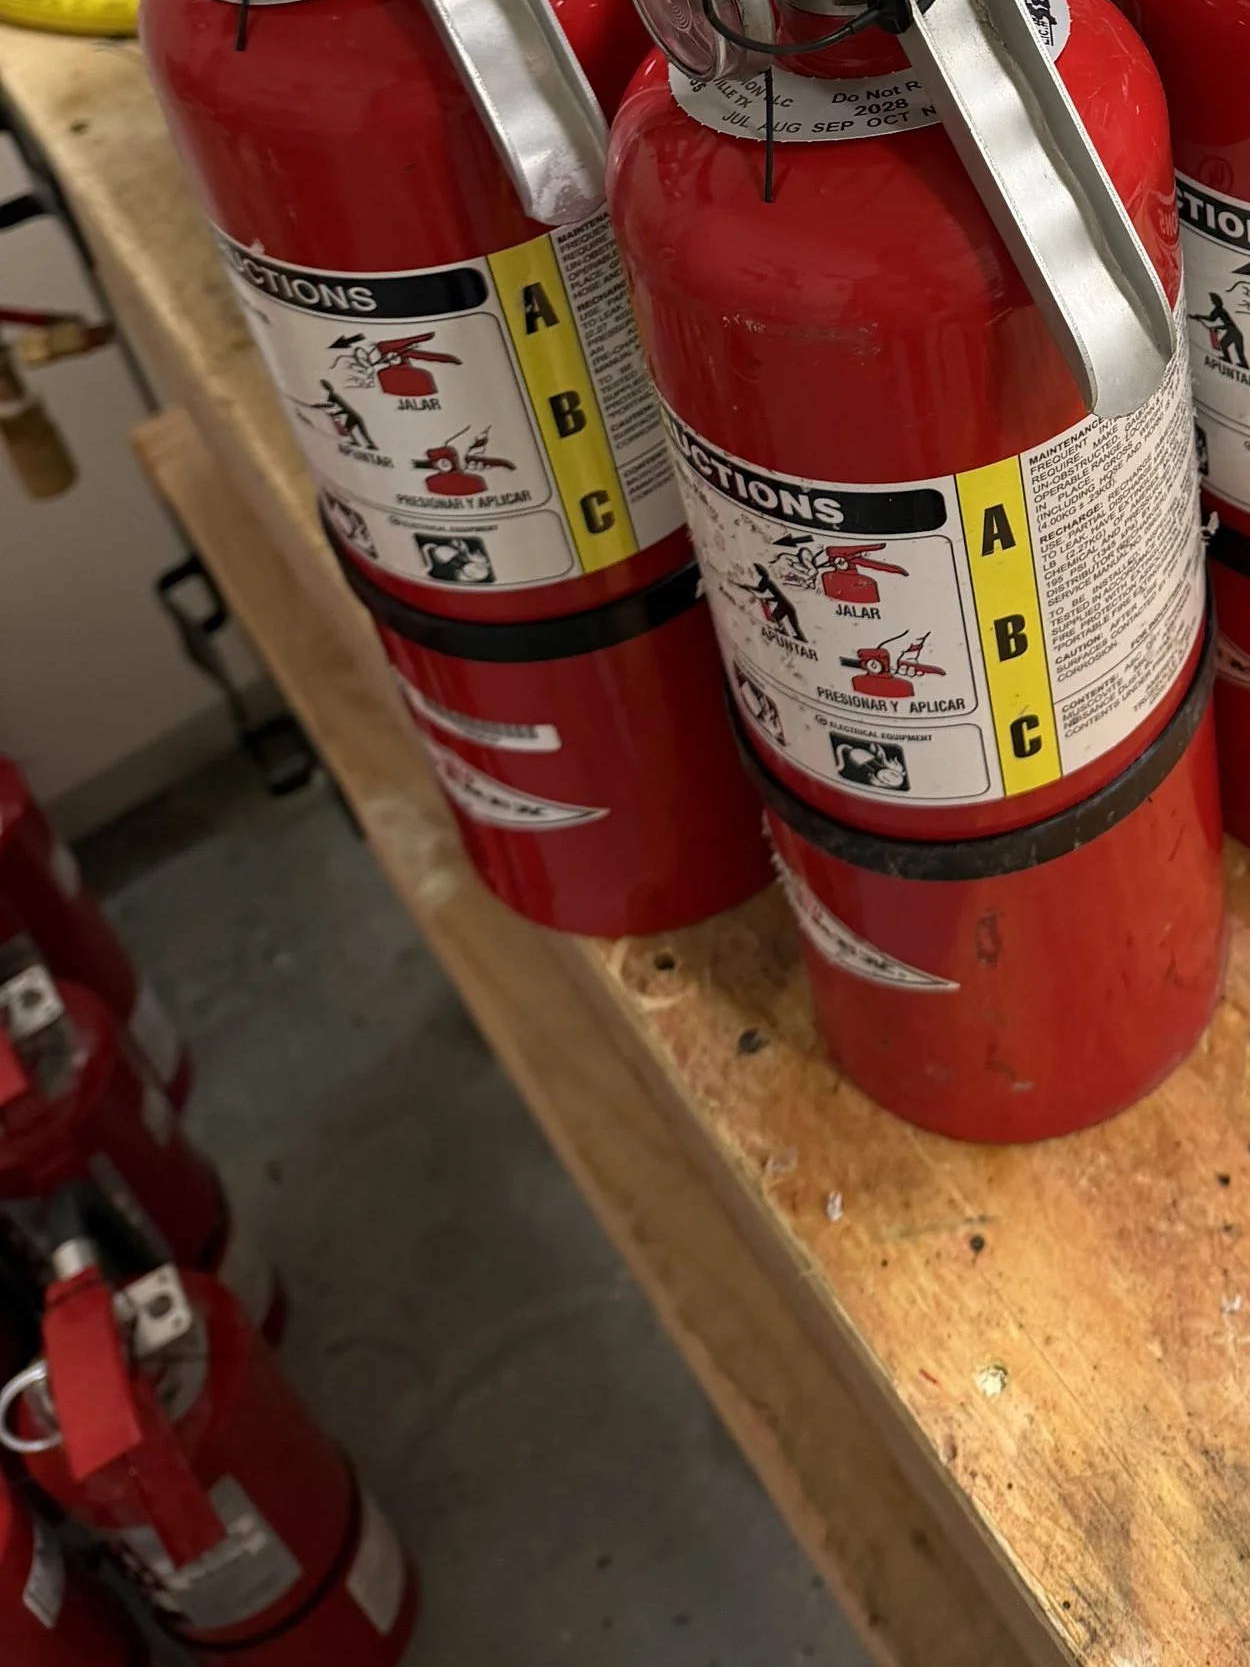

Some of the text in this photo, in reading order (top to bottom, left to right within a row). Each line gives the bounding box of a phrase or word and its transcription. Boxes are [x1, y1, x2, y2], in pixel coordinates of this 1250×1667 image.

[737, 94, 753, 109] TX
[853, 98, 909, 117] 2028
[832, 92, 859, 104] Do
[866, 85, 901, 102] Not
[722, 111, 750, 129] JUL
[811, 120, 855, 133] SEP
[866, 112, 911, 128] OCT
[558, 212, 610, 244] MAINTENA
[227, 248, 377, 312] UCTIONS
[397, 397, 441, 411] JALAR
[522, 281, 616, 535] A B C
[671, 421, 845, 524] UCTIONS
[1030, 437, 1088, 475] FREQUENT
[1031, 424, 1118, 485] REQUIRE. MAKE
[1032, 436, 1120, 494] UN-OBSTRUCTED.
[1034, 468, 1089, 503] OPERABLE
[1035, 441, 1133, 513] IN PLACE. GROSS
[1036, 441, 1142, 523] (INCLUDING HOSE AND
[395, 490, 531, 510] PRESIONAR Y APLICAR
[1037, 507, 1077, 532] (4.00KG
[1040, 502, 1104, 544] RECHARGE:
[1040, 510, 1107, 553] USE. PARTIAL
[1042, 550, 1057, 563] TO
[1090, 512, 1116, 534] HAVE
[1043, 529, 1107, 571] LB (2.27KG)
[1044, 526, 1121, 580] CHEMICAL AND
[1046, 562, 1087, 589] 195 PSI
[1047, 549, 1115, 598] DISTRIBUTOR
[1047, 549, 1129, 607] SERVICE MANUAL
[835, 603, 881, 620] JALAR
[1049, 594, 1086, 618] TO BE
[1051, 582, 1127, 636] SUPPLIED WITH
[1051, 600, 1090, 627] TESTED
[1052, 582, 1137, 646] FIRE PROTECTION
[761, 628, 819, 661] APUNTAR
[981, 504, 1043, 759] A B C
[1055, 632, 1104, 665] CAUTION:
[1056, 638, 1108, 674] SURFACES
[816, 687, 965, 714] PRESIONAR Y APLICAR
[1062, 677, 1123, 722] MUSCOVITE
[1064, 698, 1120, 738] CONTENTS
